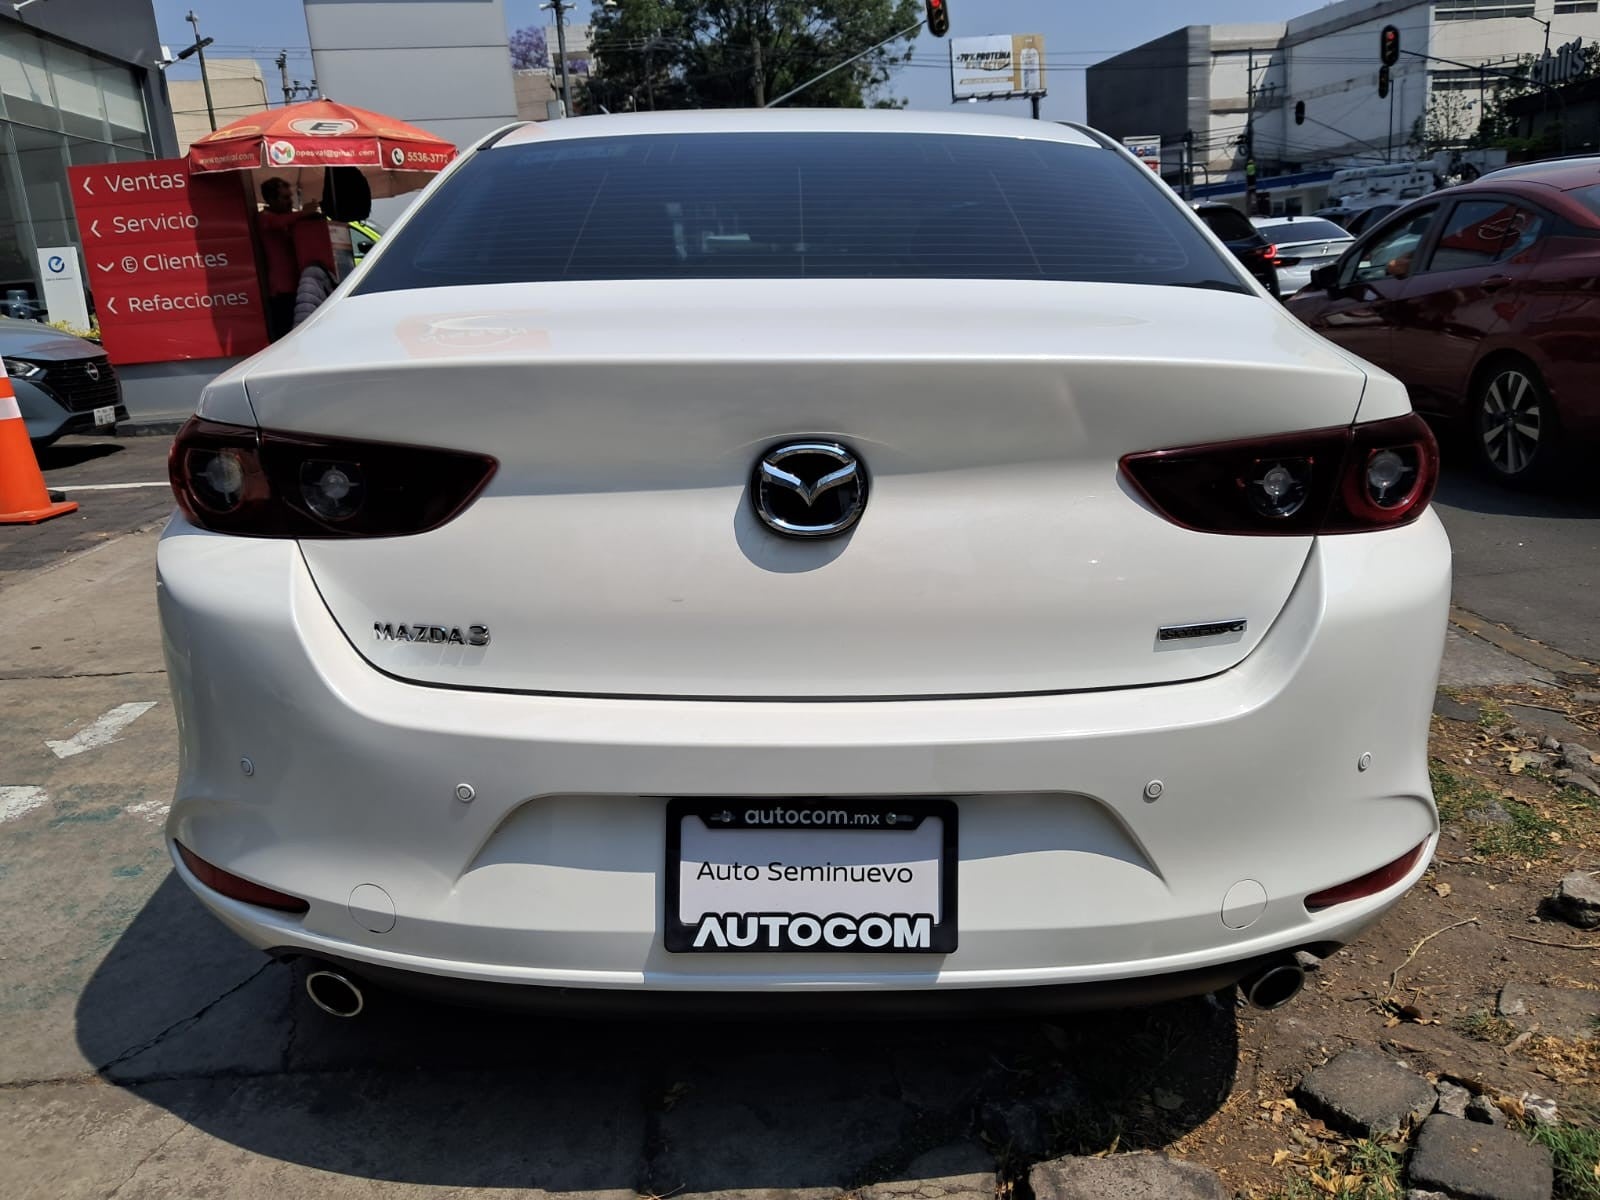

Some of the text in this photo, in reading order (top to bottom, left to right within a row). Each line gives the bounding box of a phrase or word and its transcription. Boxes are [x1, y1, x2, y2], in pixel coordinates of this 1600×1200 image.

[104, 170, 186, 193] Ventas
[112, 212, 200, 234] Servicio
[143, 250, 229, 272] Clientes
[128, 289, 249, 312] Refacciones
[744, 807, 880, 826] autocom.mx
[697, 861, 913, 883] Auto Seminuevo
[693, 916, 931, 948] AUTOCOM
